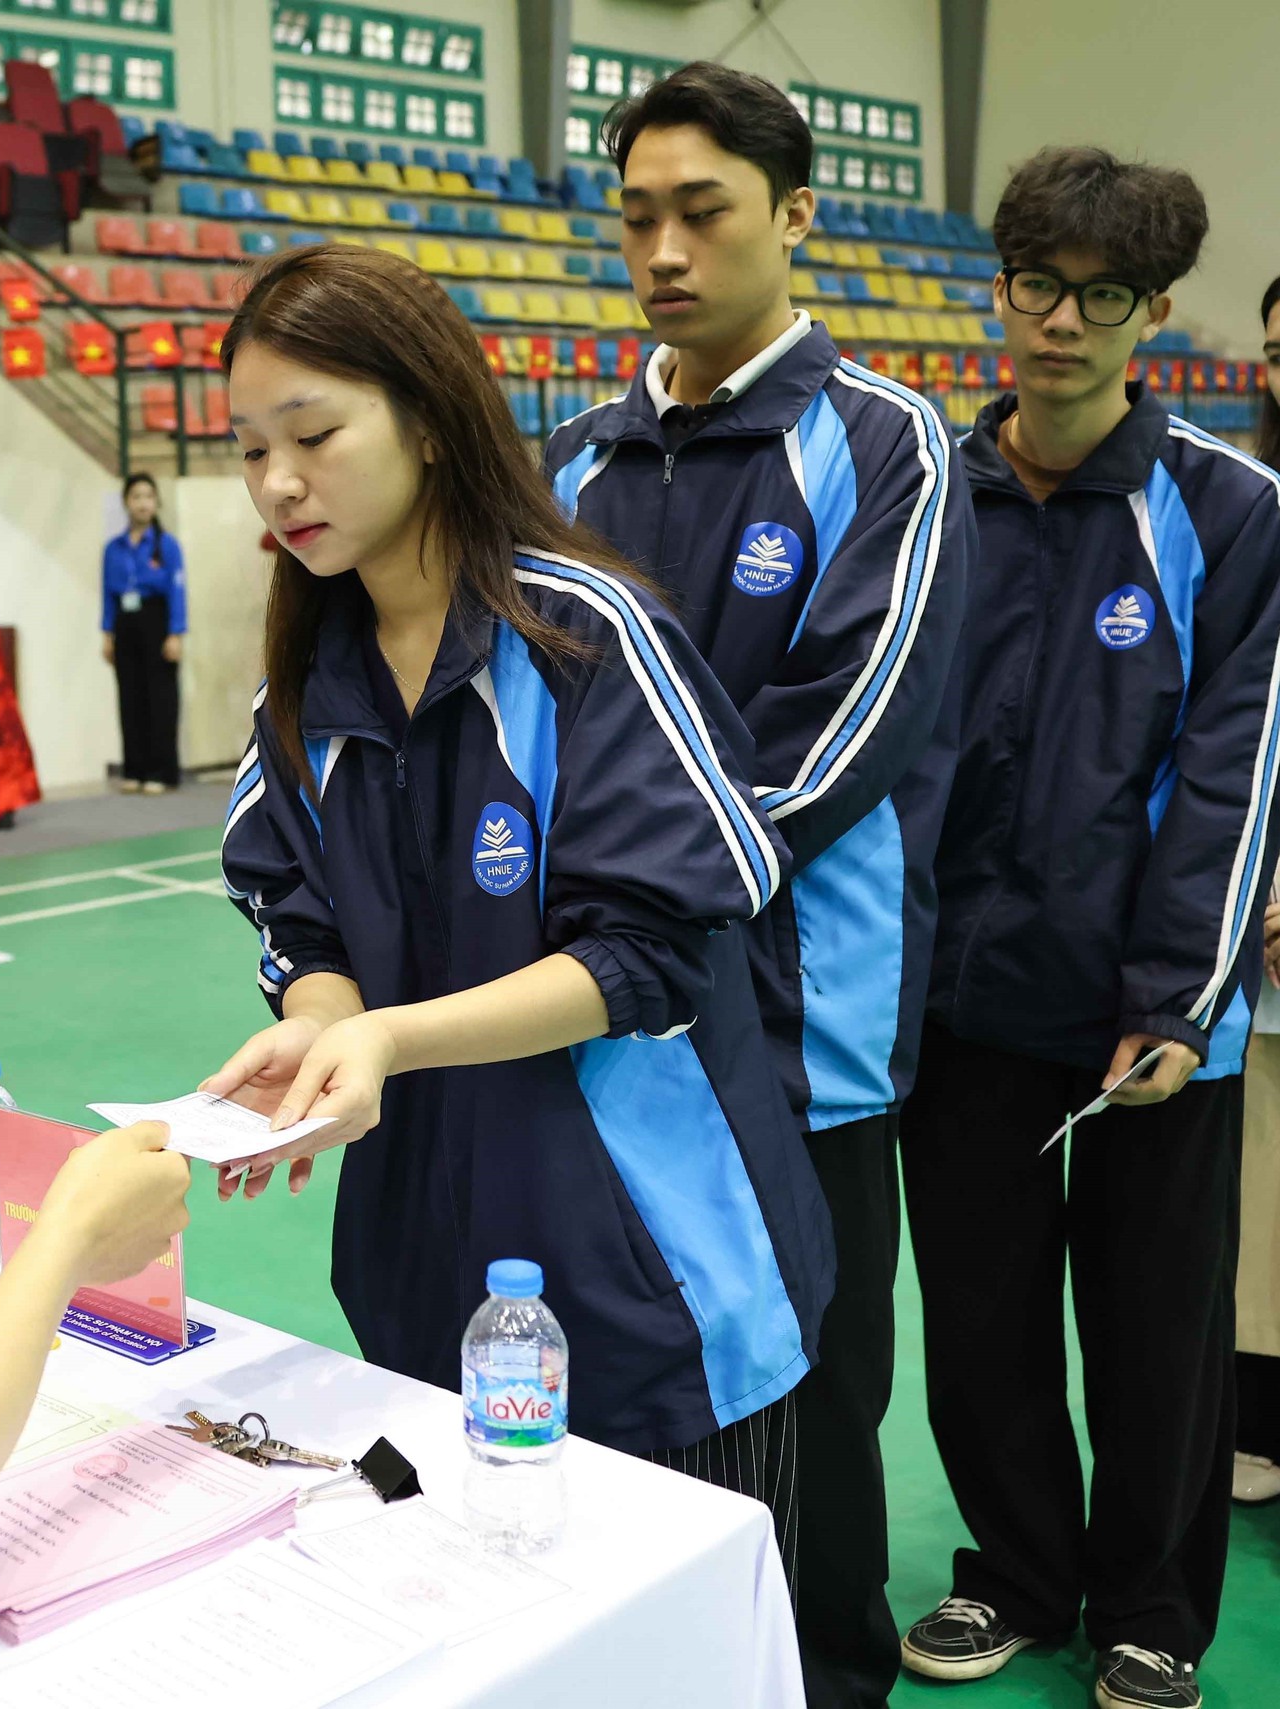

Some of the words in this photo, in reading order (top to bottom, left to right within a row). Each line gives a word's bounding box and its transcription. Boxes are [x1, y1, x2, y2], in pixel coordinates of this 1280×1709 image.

[744, 569, 776, 583] HNUE
[1110, 627, 1133, 638] HNUE
[487, 864, 512, 876] HNUE
[66, 1317, 103, 1334] University
[101, 1330, 111, 1338] of
[109, 1332, 148, 1351] Education
[74, 1312, 94, 1323] HỌC
[93, 1318, 108, 1328] SƯ
[106, 1322, 133, 1337] PHẠM
[144, 1336, 163, 1349] NỘI
[486, 1396, 552, 1420] laVie
